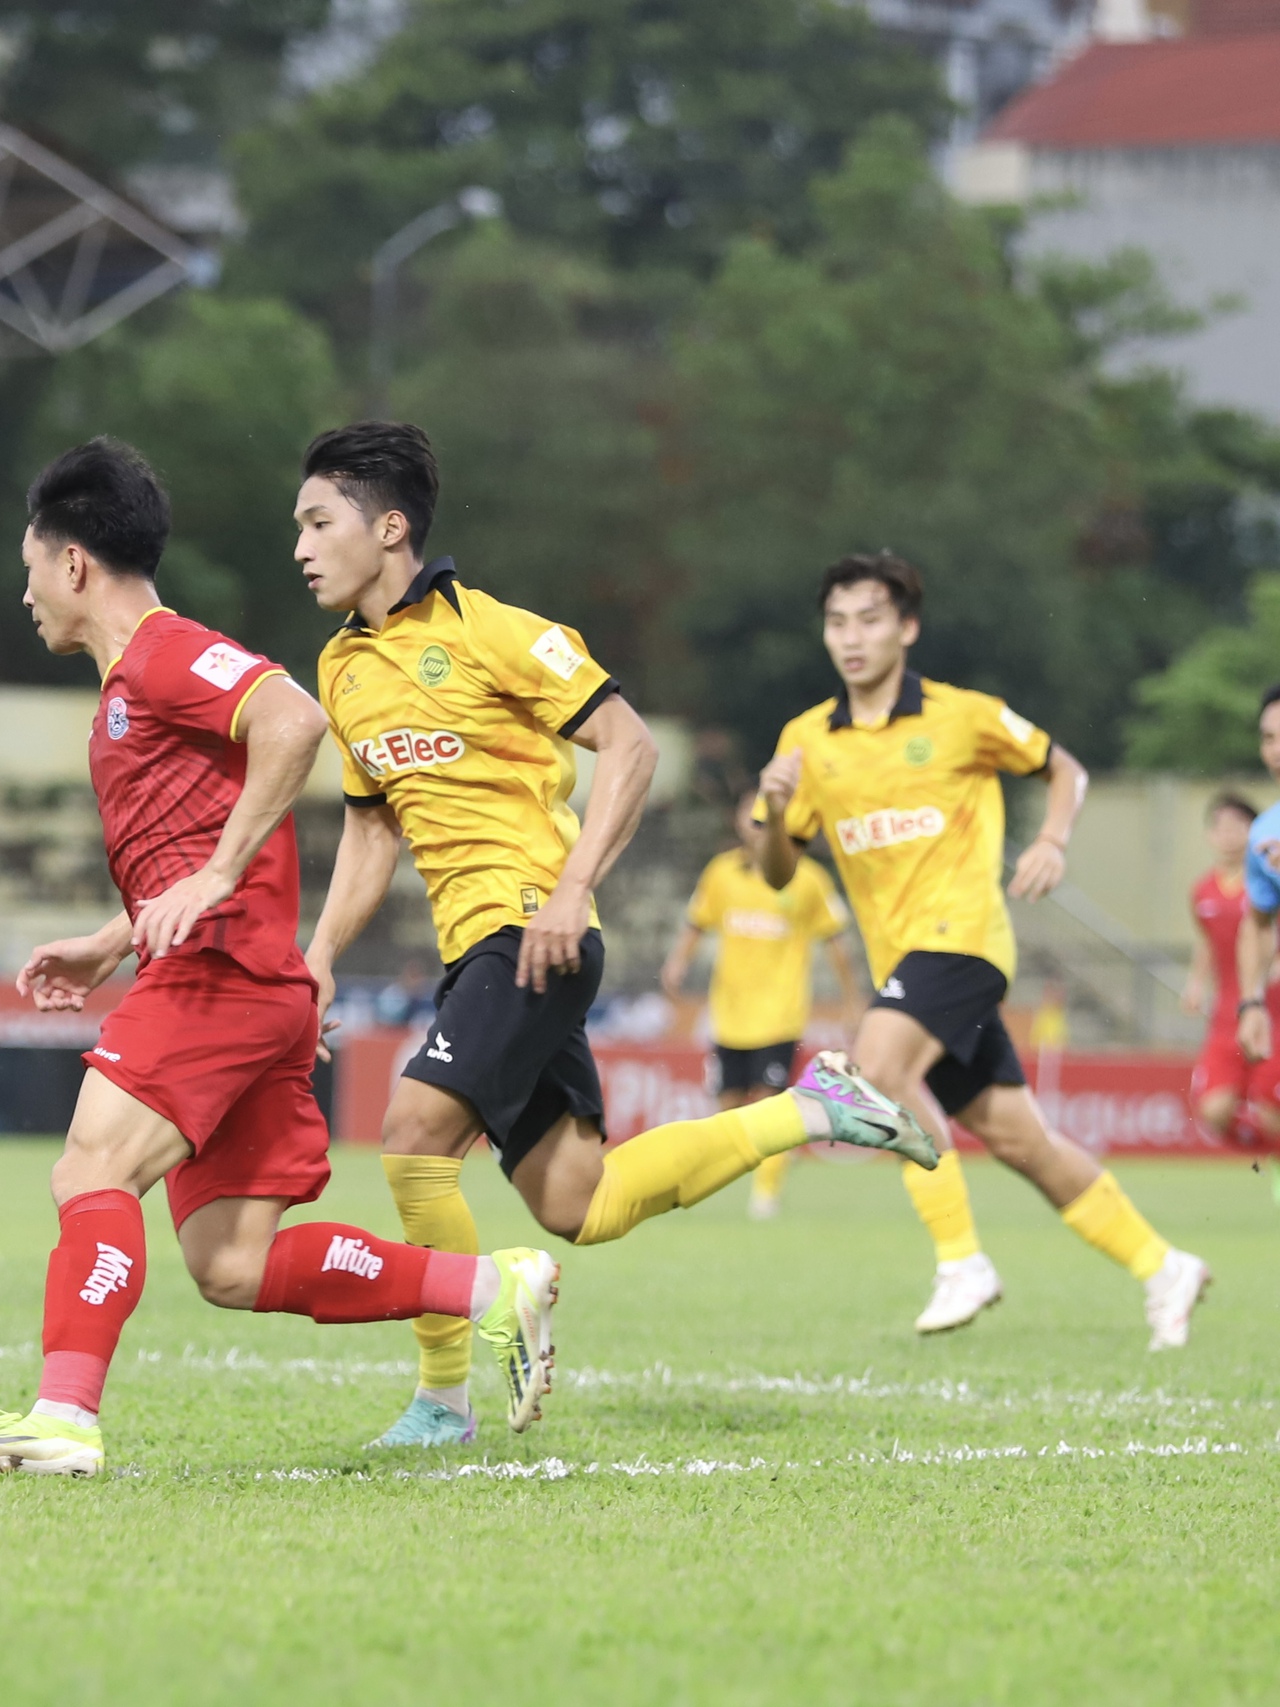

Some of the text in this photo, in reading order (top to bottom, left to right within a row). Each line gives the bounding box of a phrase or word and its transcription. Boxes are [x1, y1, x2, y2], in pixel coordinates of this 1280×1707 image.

[353, 733, 460, 773] K-Elec
[79, 1242, 133, 1305] Mitre
[321, 1235, 384, 1280] Mitre
